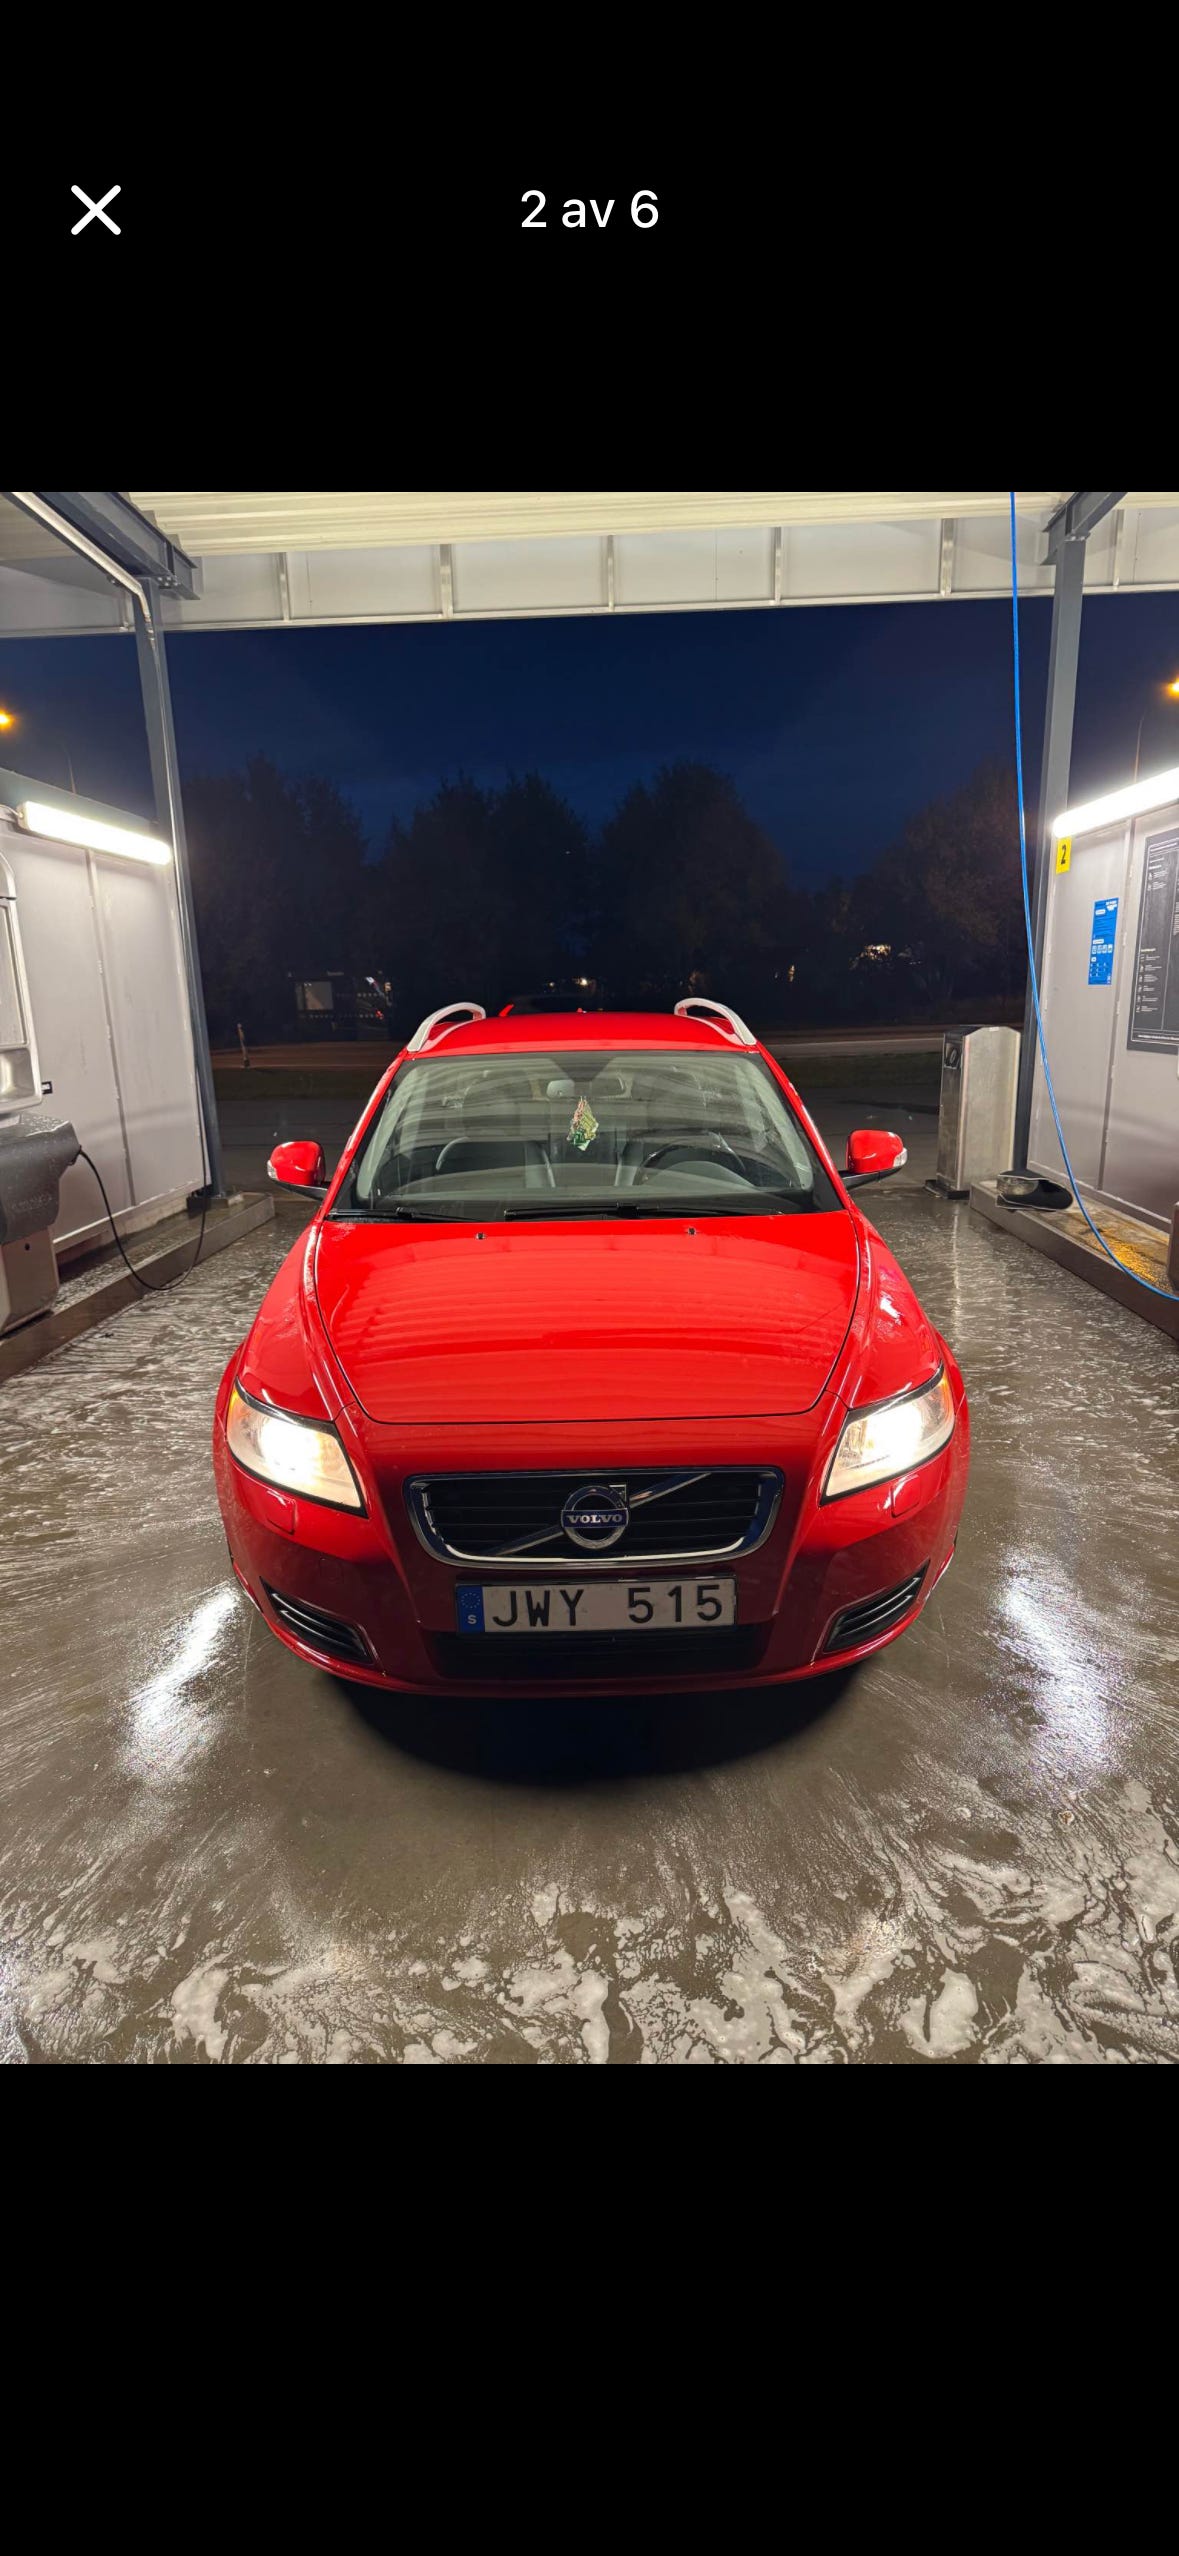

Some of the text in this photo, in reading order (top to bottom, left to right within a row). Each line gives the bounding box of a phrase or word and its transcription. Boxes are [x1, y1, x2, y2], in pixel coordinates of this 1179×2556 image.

[1060, 843, 1067, 865] 2
[567, 1512, 623, 1525] VOLVO
[491, 1583, 723, 1628] JWY 515
[466, 1614, 477, 1625] S
